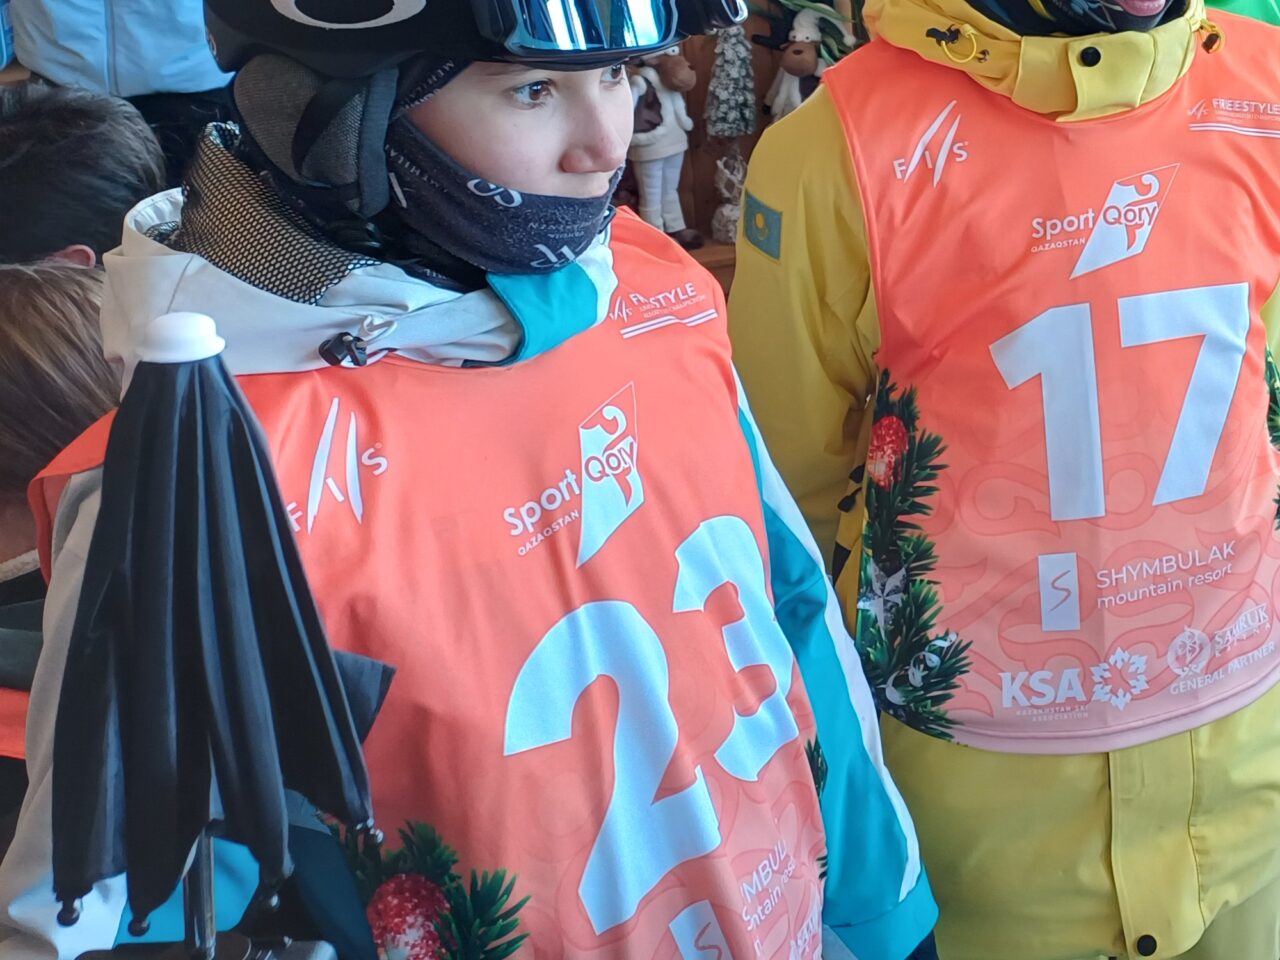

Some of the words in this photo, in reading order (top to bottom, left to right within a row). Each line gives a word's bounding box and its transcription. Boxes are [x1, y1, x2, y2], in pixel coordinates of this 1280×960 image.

[1211, 98, 1280, 115] FREESTYLE
[1030, 237, 1086, 253] QAZAQSTAN
[1031, 208, 1095, 240] Sport
[1102, 204, 1158, 227] Qory
[628, 282, 697, 309] FSTYLE
[988, 282, 1251, 522] 17
[503, 468, 581, 536] Sport
[517, 509, 580, 557] QAZAQSTAN
[1096, 580, 1184, 610] mountain
[1188, 562, 1233, 588] resort
[1097, 540, 1236, 589] SHYMBULAK
[999, 667, 1088, 709] KSA
[1170, 670, 1225, 696] GENERAL
[1228, 640, 1276, 674] PARTNER
[503, 515, 798, 936] 23
